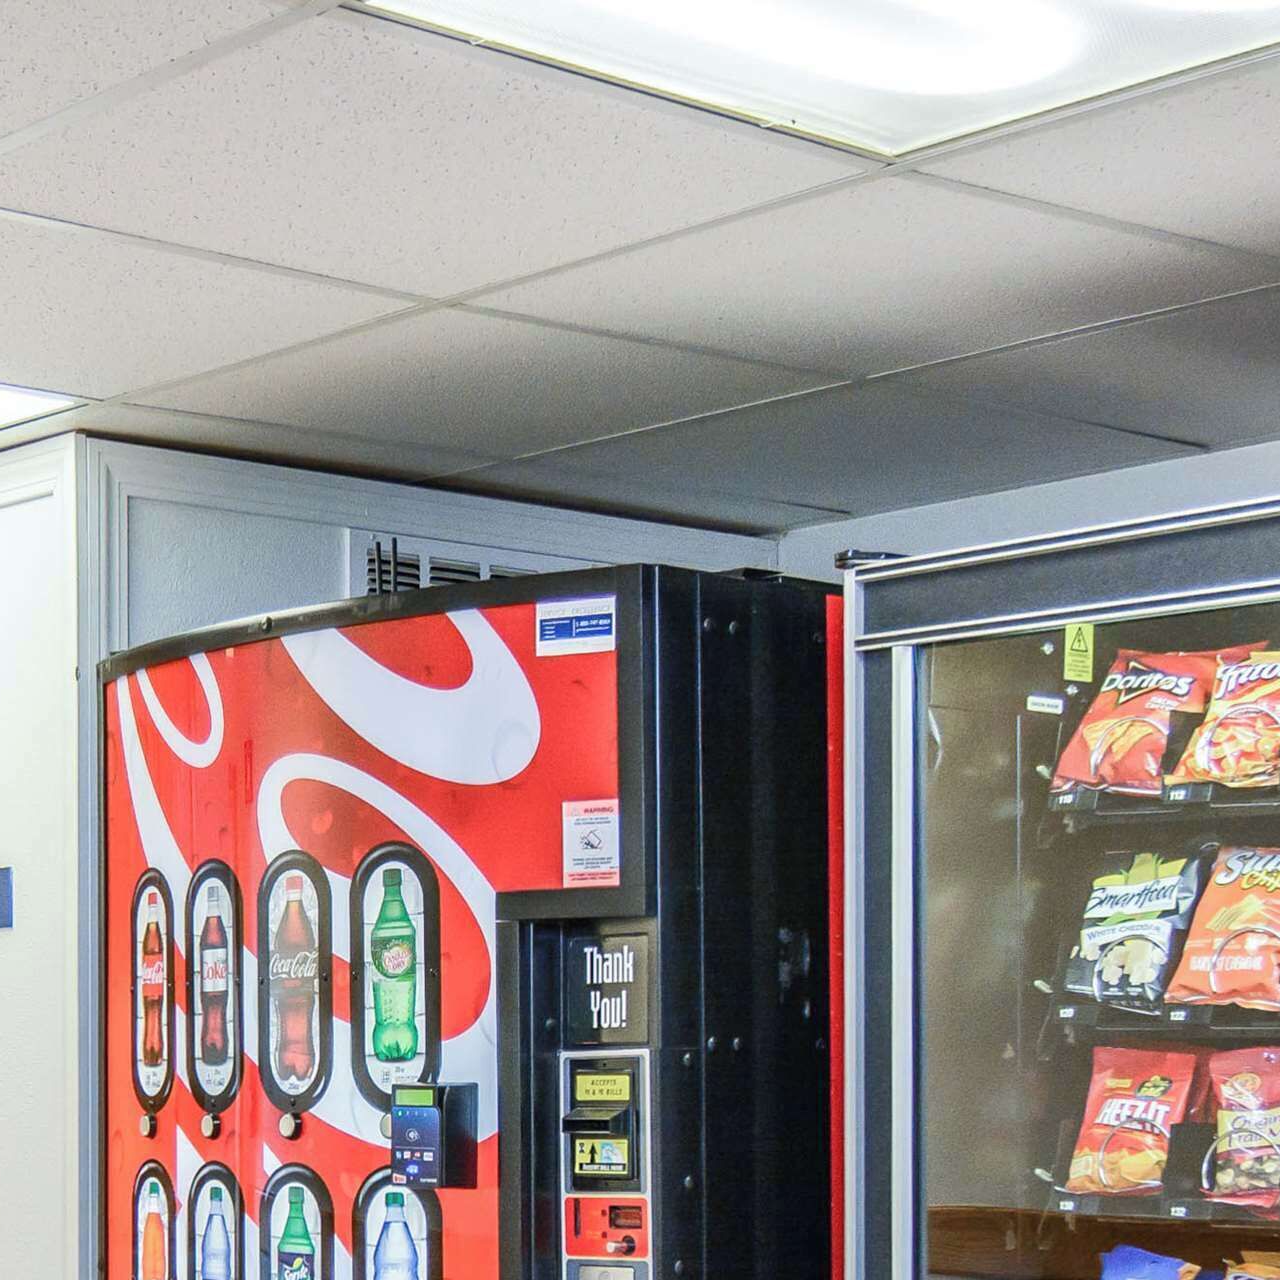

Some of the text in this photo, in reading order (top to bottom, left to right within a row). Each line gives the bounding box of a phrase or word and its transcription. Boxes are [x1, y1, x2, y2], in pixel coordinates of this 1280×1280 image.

[1101, 671, 1196, 697] Doritos
[583, 945, 634, 985] Thank
[590, 990, 628, 1029] You!
